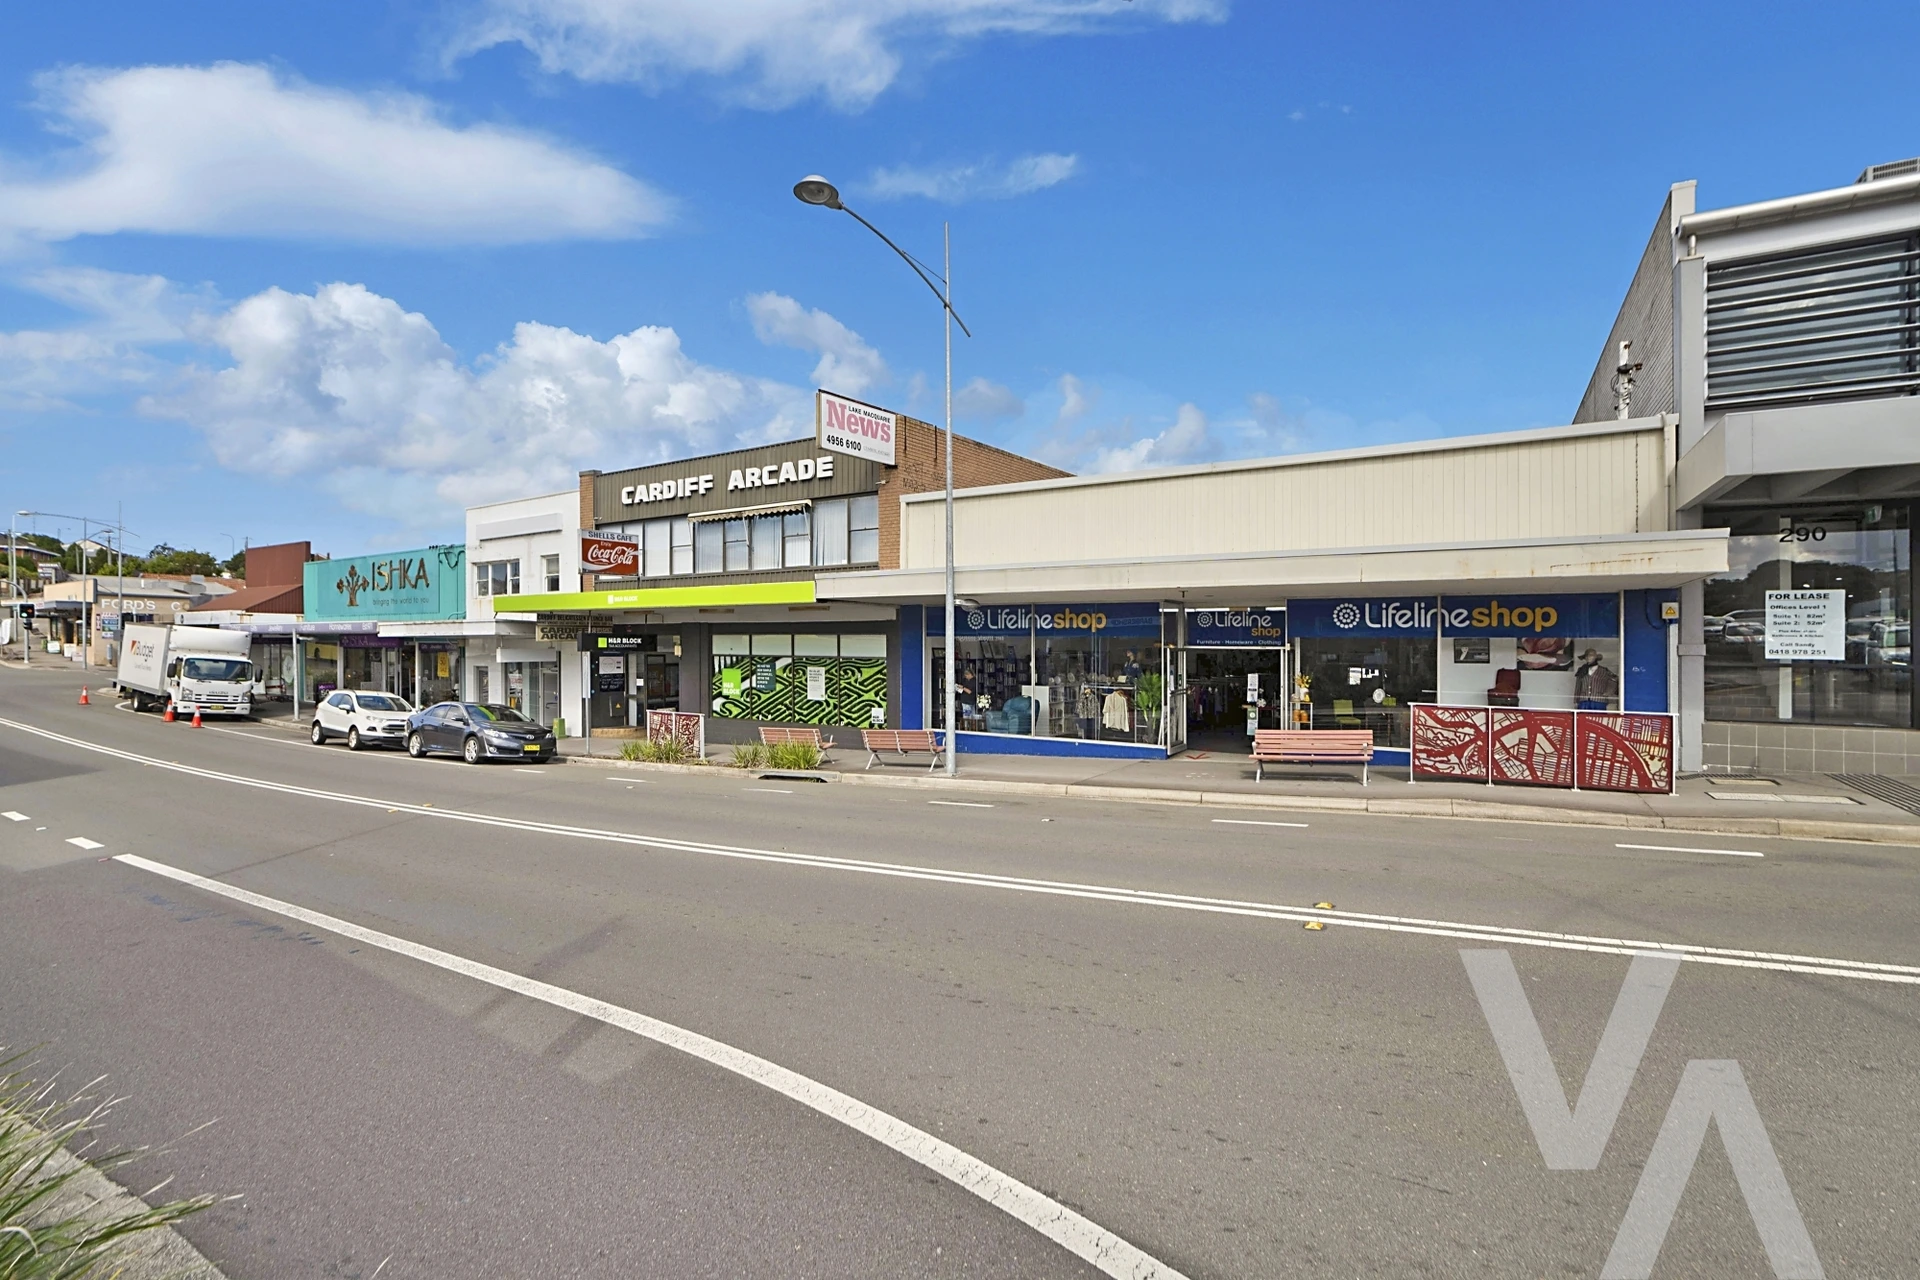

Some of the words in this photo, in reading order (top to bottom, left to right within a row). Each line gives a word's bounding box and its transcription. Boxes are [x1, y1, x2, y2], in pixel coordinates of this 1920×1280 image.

[848, 406, 862, 415] LAKE
[826, 399, 891, 443] News
[826, 434, 844, 447] 4956
[845, 439, 862, 452] 6100
[621, 473, 714, 505] CARDIFF
[728, 455, 834, 491] ARCADE
[588, 531, 615, 540] SHELLS
[616, 534, 633, 542] CAFE
[1779, 526, 1827, 543] 290
[372, 557, 430, 591] ISHKA
[101, 599, 156, 610] FORD'S
[1215, 611, 1272, 627] Lifeline
[1251, 626, 1281, 638] shop
